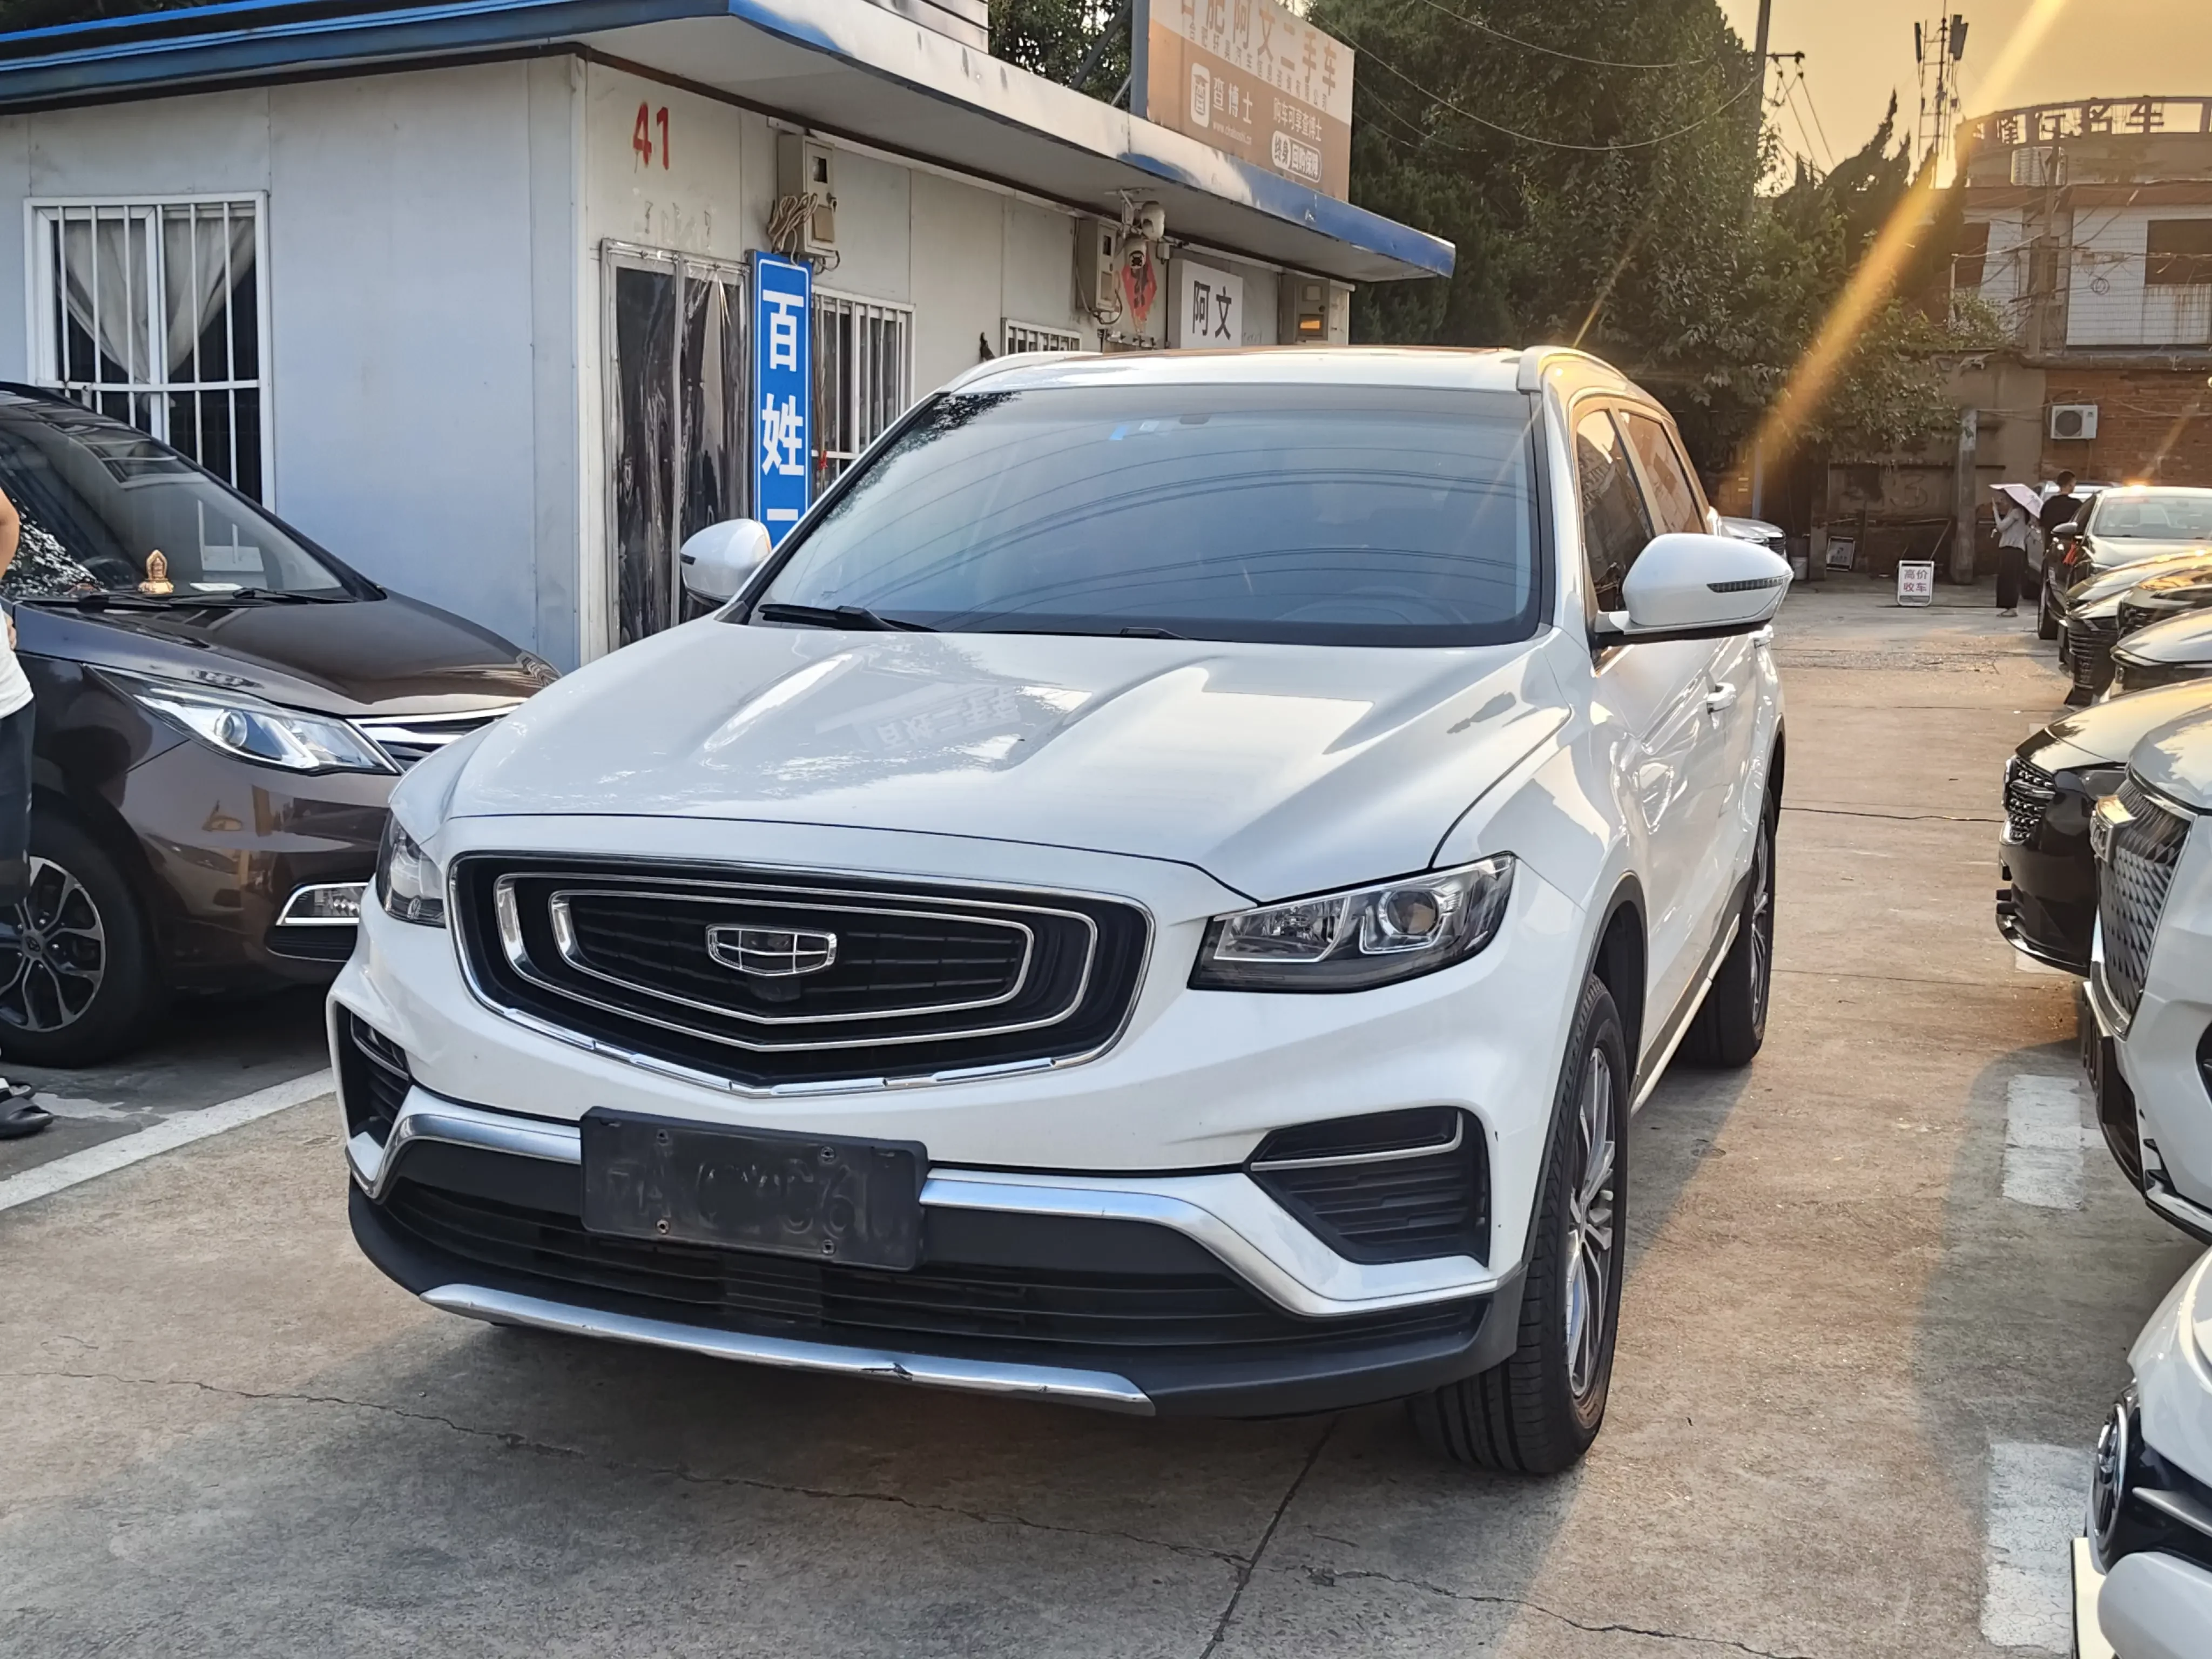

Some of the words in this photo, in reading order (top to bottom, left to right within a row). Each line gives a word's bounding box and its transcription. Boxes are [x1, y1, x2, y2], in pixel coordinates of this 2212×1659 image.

[1213, 77, 1253, 125] 查博士
[1272, 97, 1323, 142] 购车可享查博士
[632, 102, 670, 170] 41
[1192, 280, 1233, 340] 阿文
[1903, 582, 1927, 592] 收车
[1904, 569, 1928, 580] 高价
